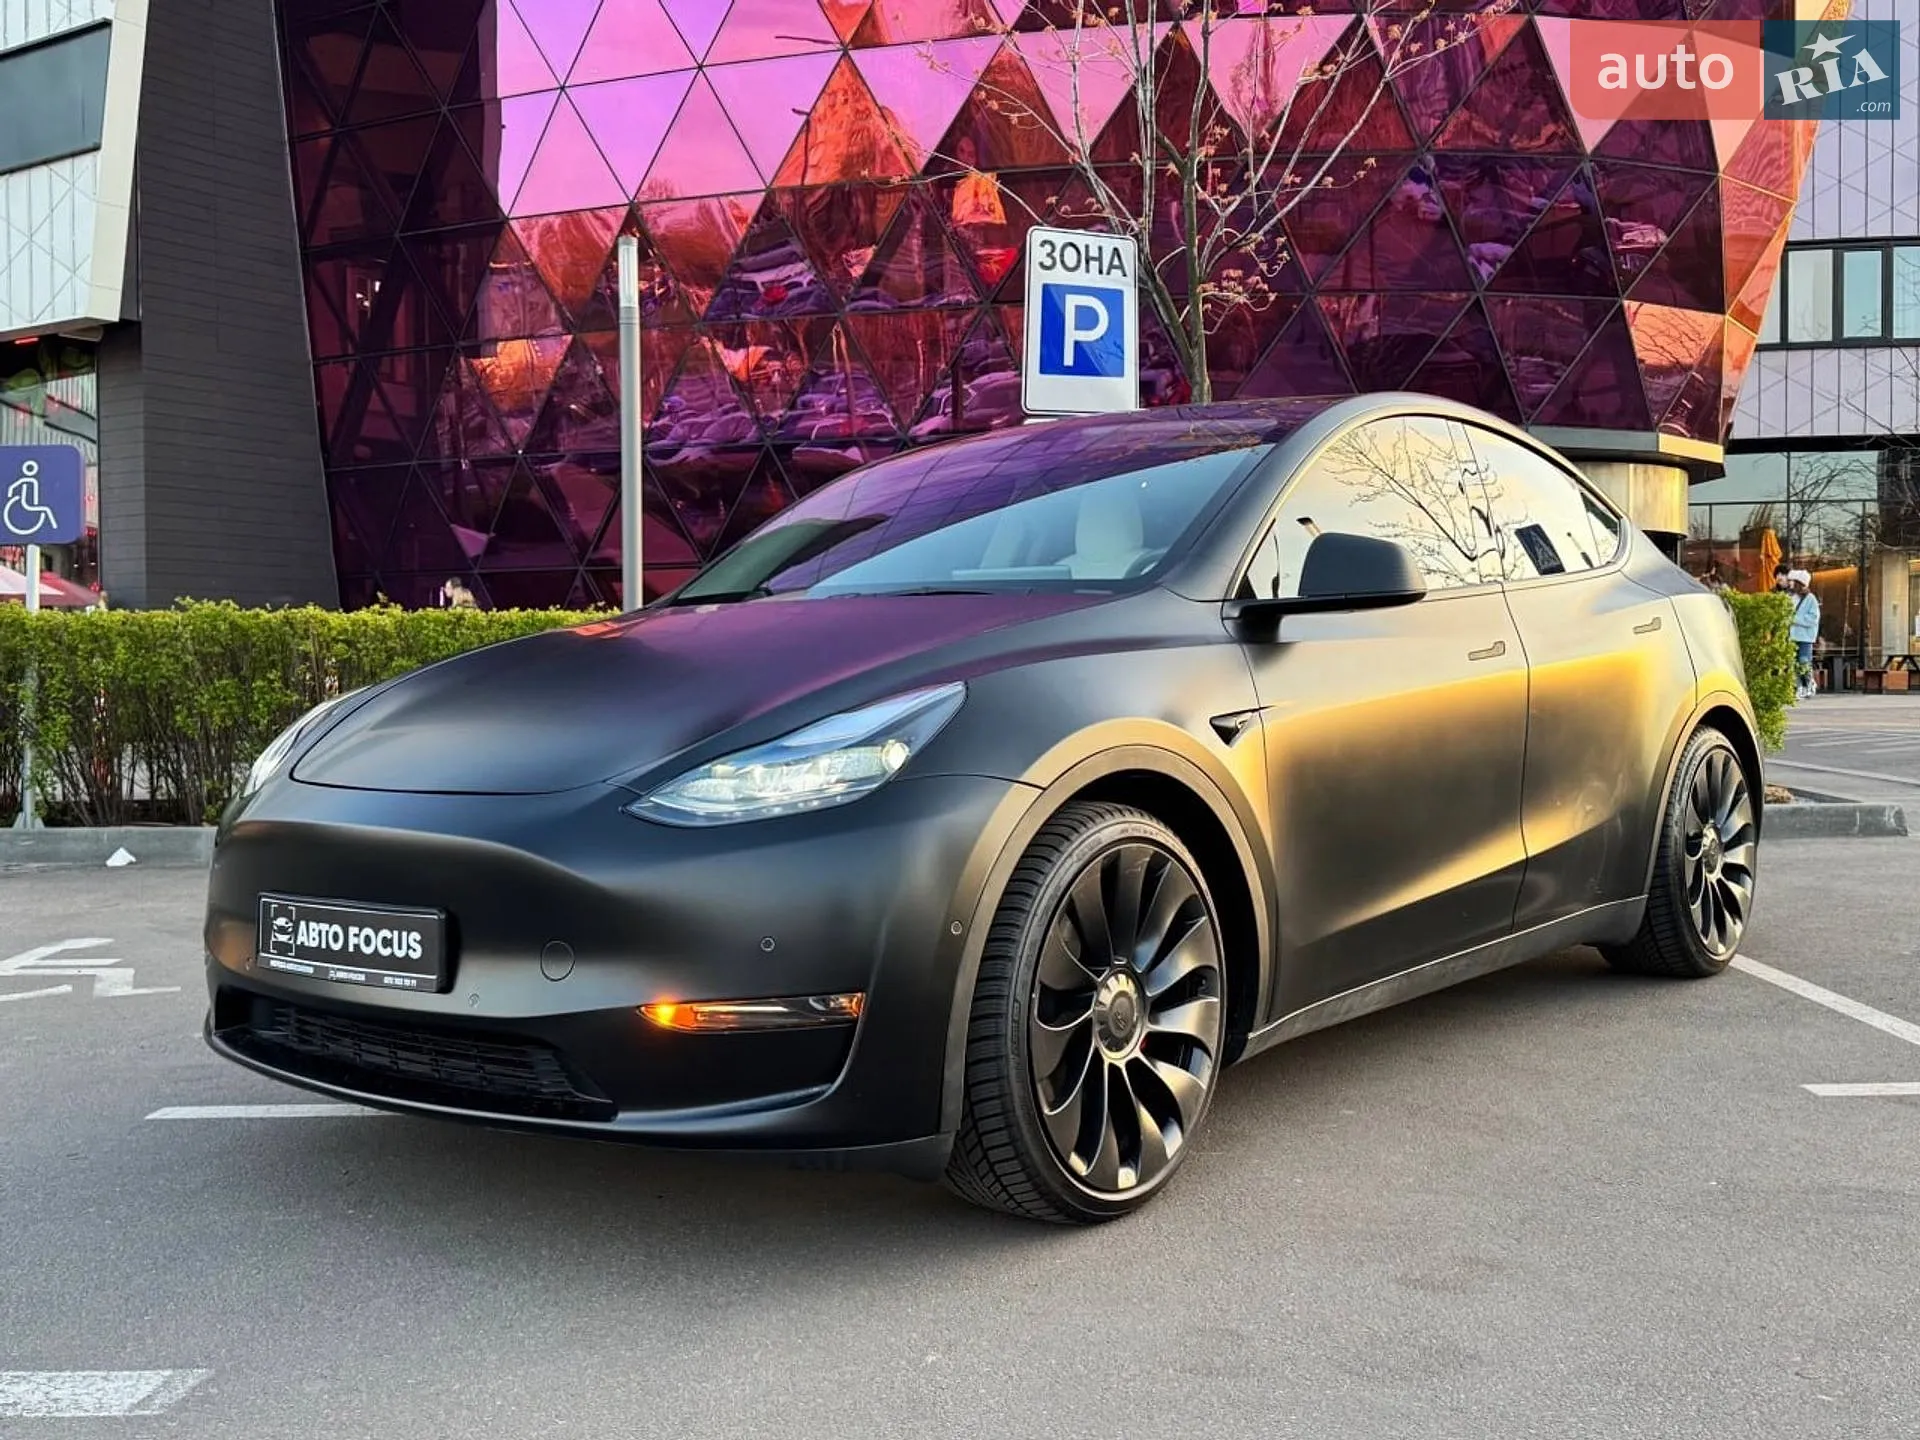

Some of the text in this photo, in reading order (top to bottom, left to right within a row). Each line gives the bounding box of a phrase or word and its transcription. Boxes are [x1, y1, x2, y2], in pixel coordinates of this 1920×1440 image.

[1037, 239, 1127, 277] ЗОНА
[1063, 293, 1109, 367] P
[296, 920, 423, 960] АВТО FOCUS
